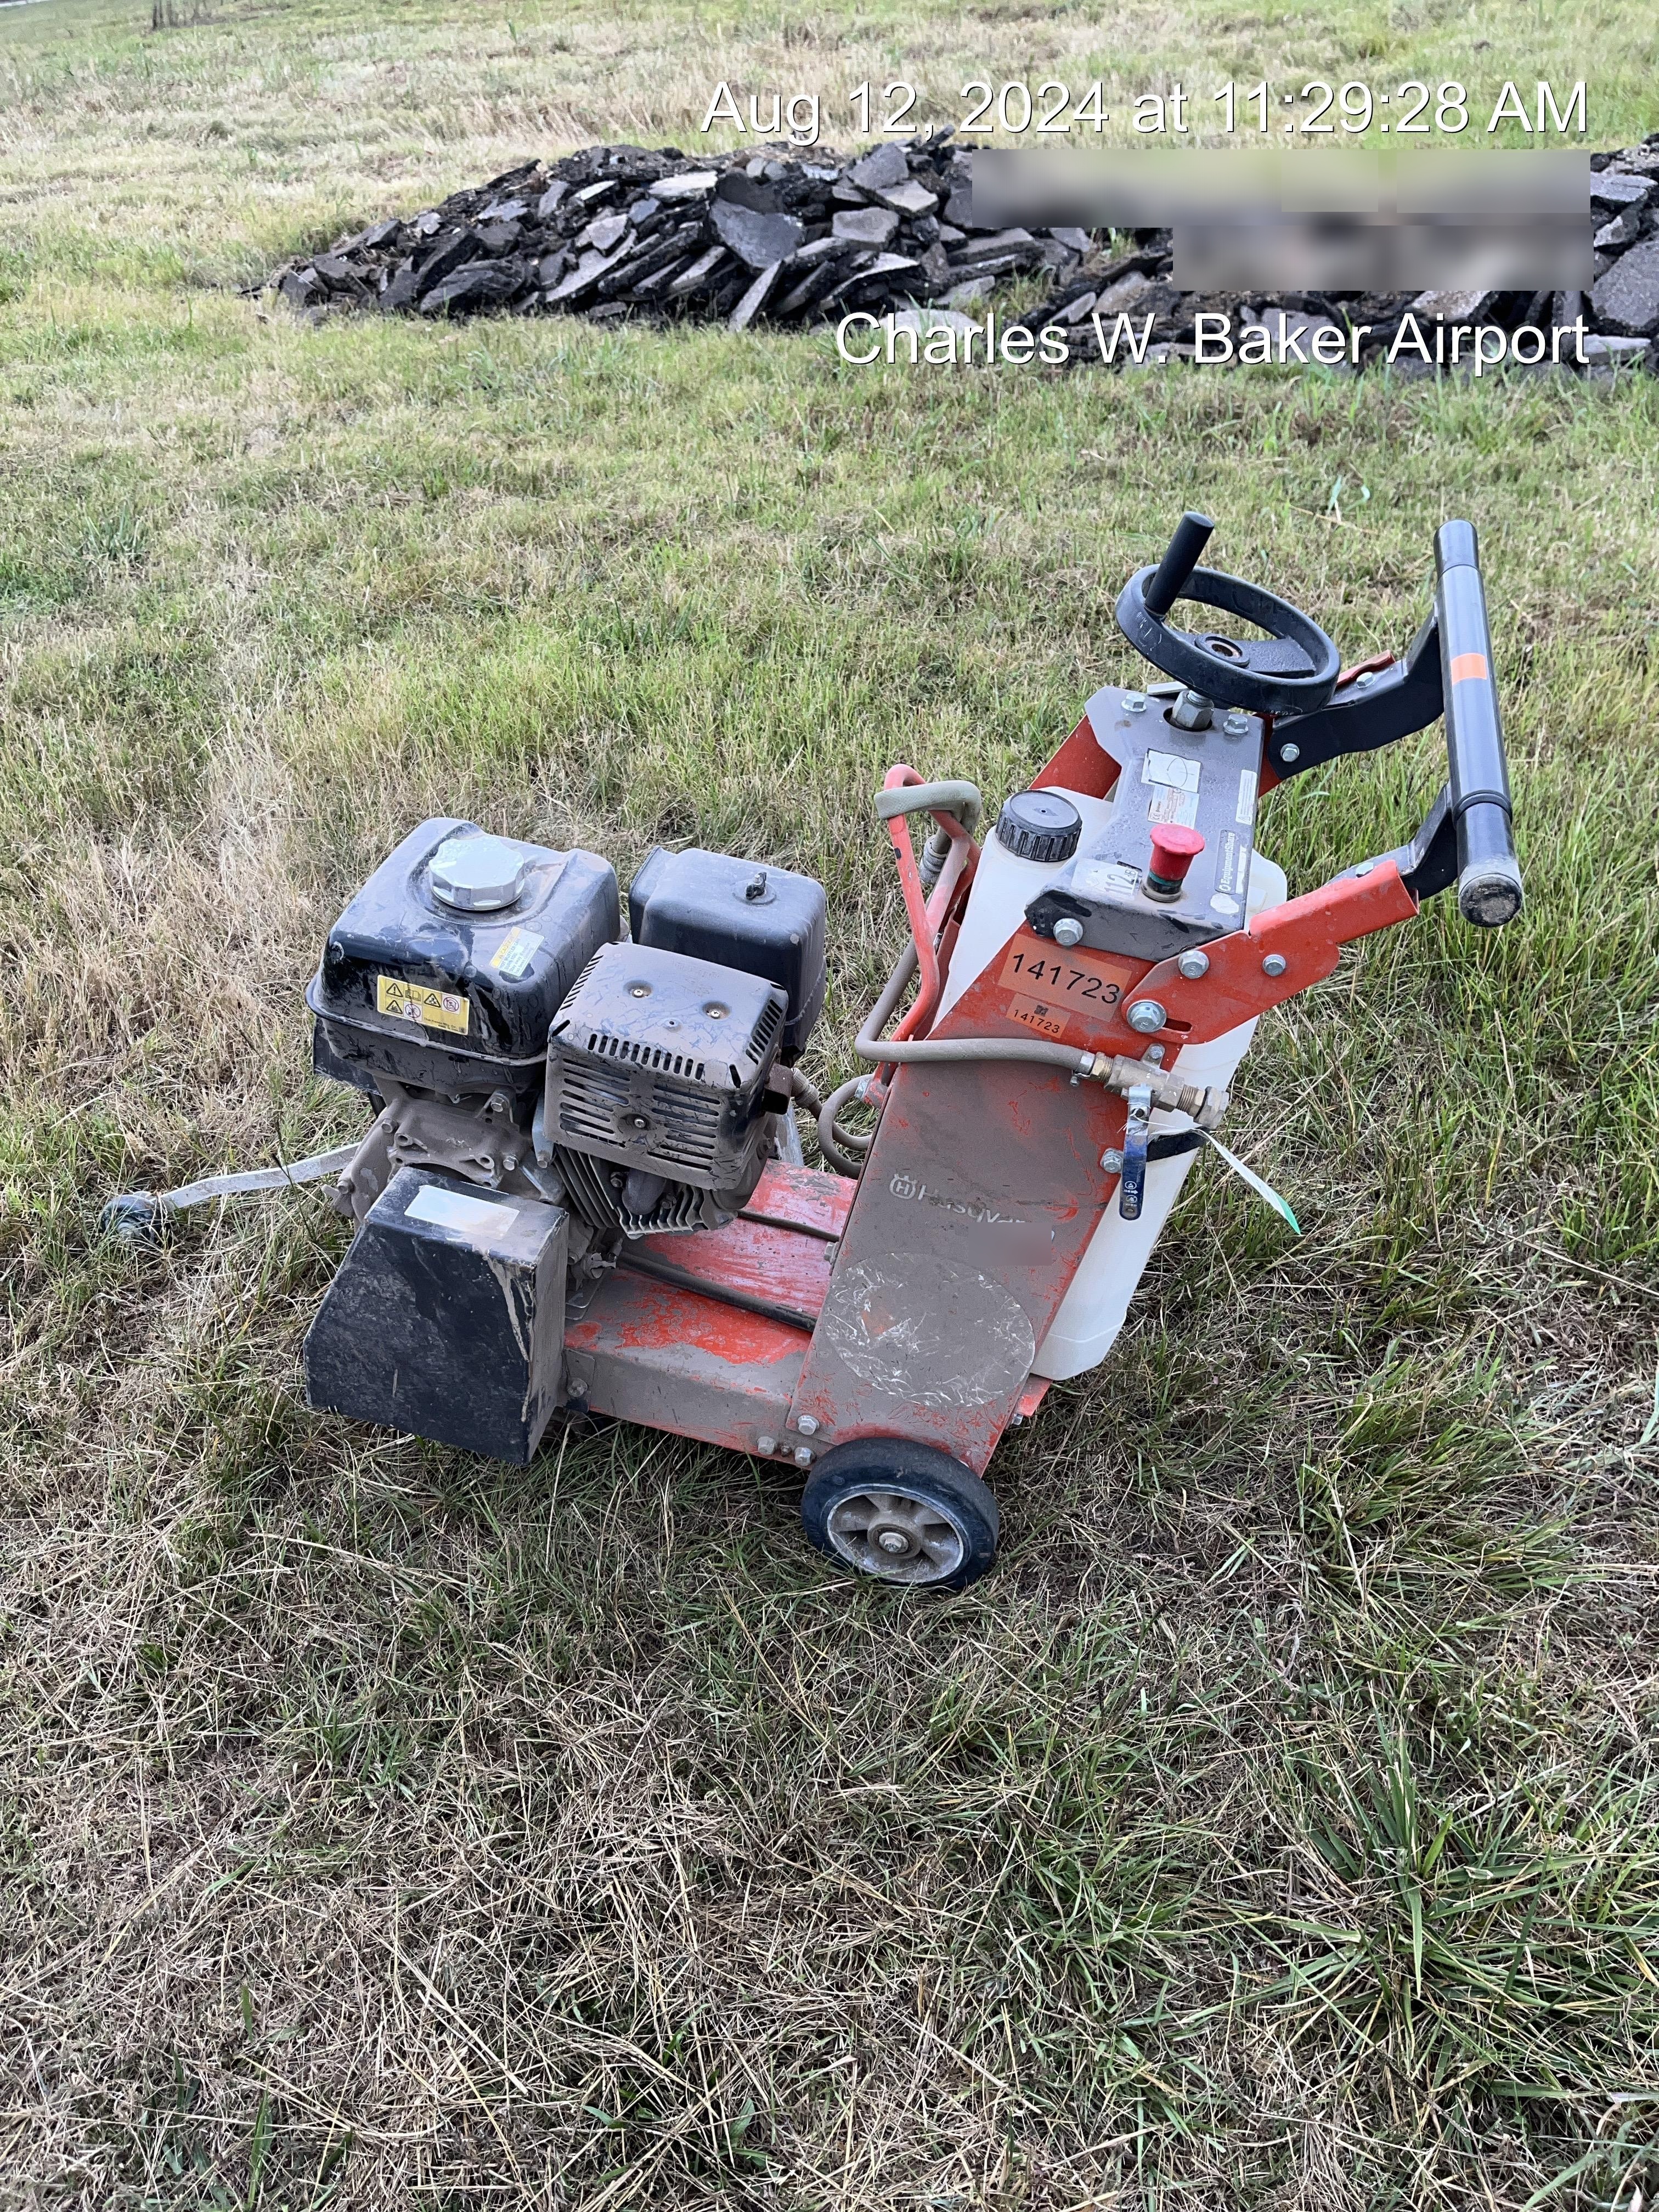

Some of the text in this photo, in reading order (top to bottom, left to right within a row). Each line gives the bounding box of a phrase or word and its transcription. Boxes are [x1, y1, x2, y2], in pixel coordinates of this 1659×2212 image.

[1220, 832, 1235, 885] EquipmentShare
[1104, 873, 1135, 894] 112
[1013, 953, 1120, 1004] 141723
[1014, 1009, 1060, 1033] 141723
